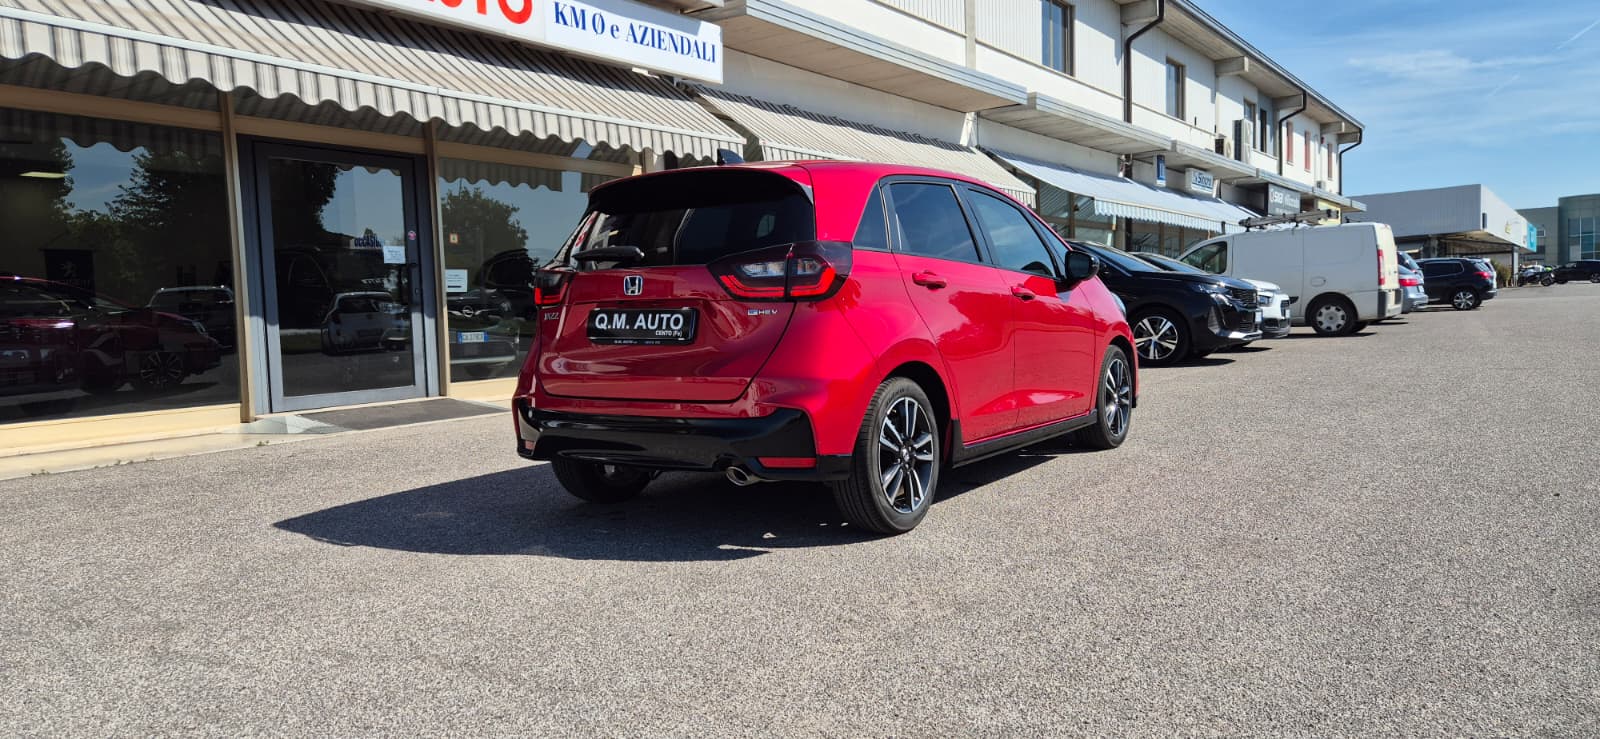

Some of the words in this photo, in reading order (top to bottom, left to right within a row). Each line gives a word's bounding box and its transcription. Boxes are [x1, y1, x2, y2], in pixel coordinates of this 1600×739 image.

[554, 2, 586, 29] KM
[610, 25, 620, 39] e
[625, 22, 717, 63] AZIENDALI
[595, 313, 630, 331] Q.M.
[633, 313, 684, 331] AUTO
